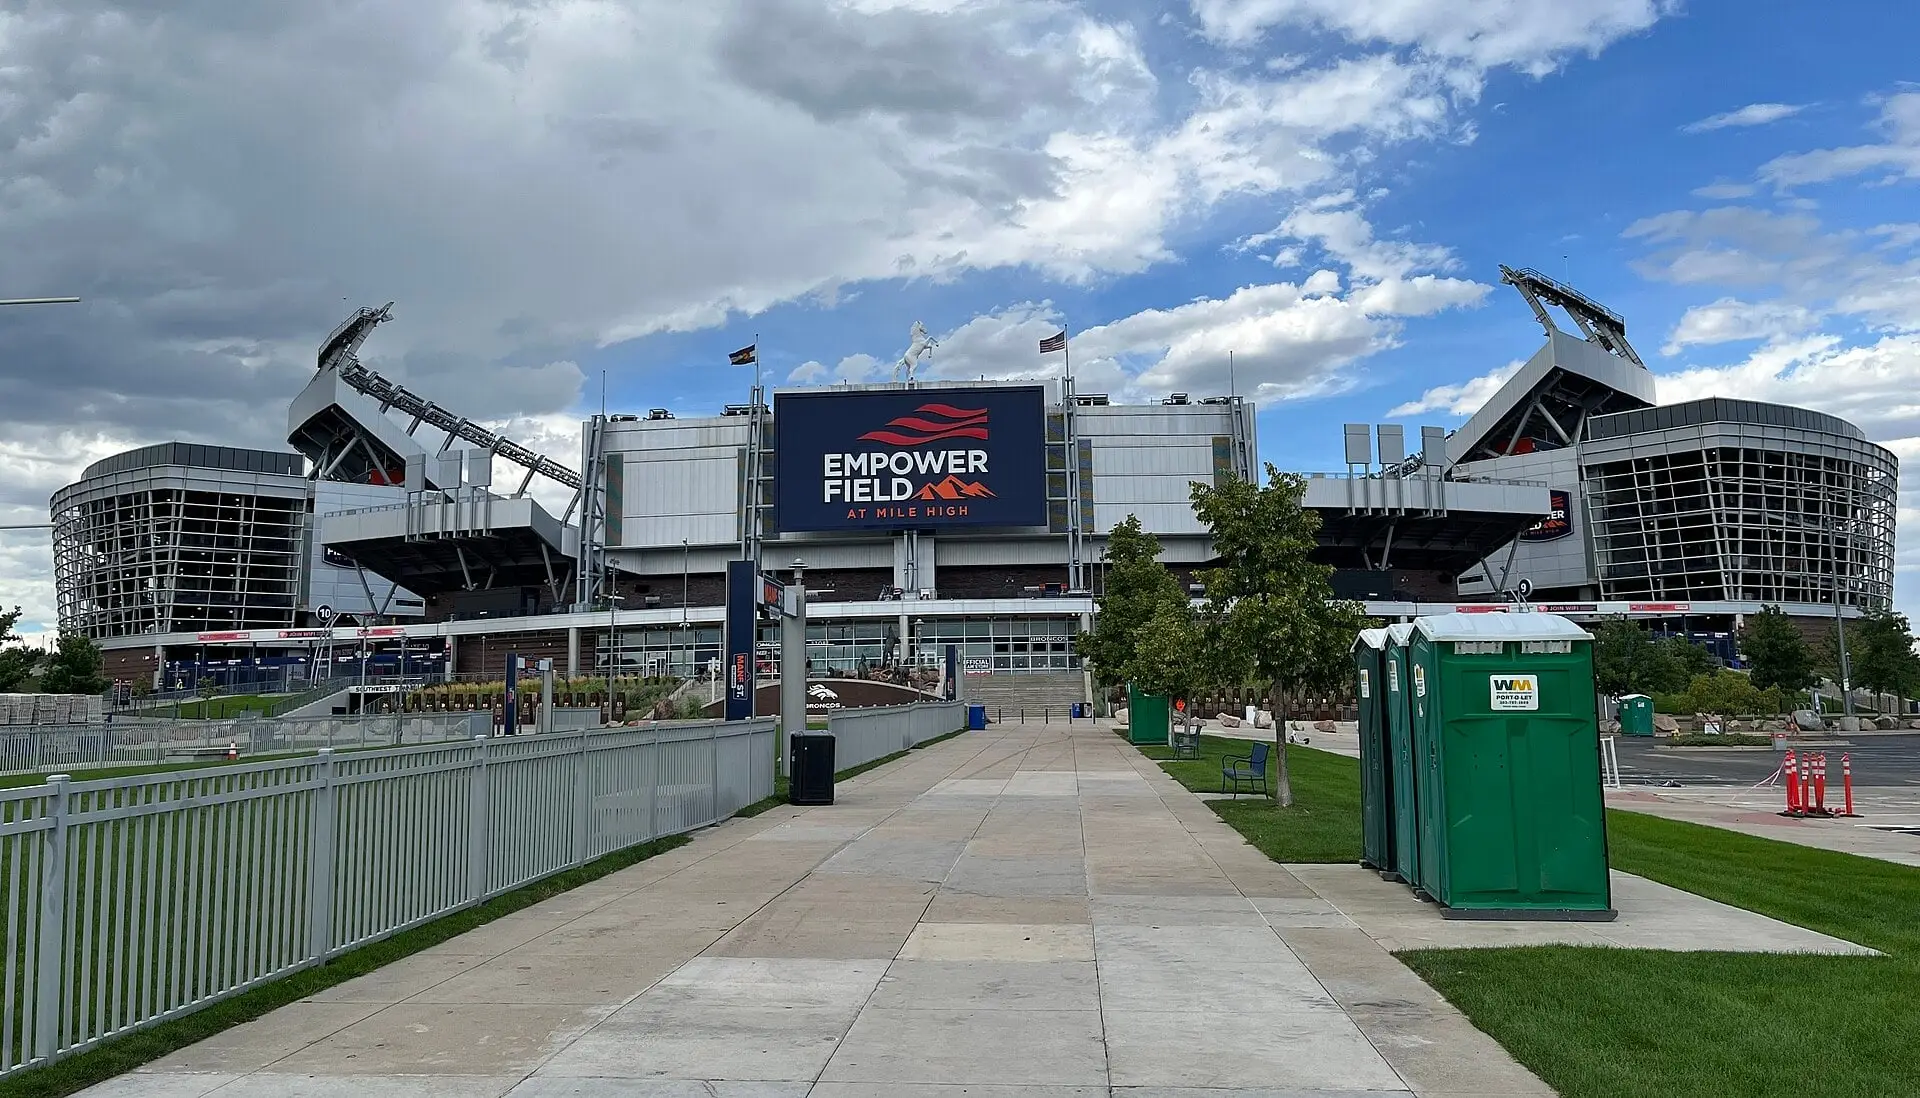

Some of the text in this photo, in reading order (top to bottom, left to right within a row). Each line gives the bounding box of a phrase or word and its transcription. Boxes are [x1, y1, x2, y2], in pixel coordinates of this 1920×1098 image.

[824, 450, 988, 477] EMPOWER
[824, 477, 913, 503] FIELD
[847, 506, 968, 519] AT MILE HIGH
[1520, 583, 1527, 593] 9
[319, 608, 331, 618] 10
[736, 655, 744, 683] MANE
[355, 685, 392, 693] SUTHWEST
[1494, 680, 1532, 690] WM
